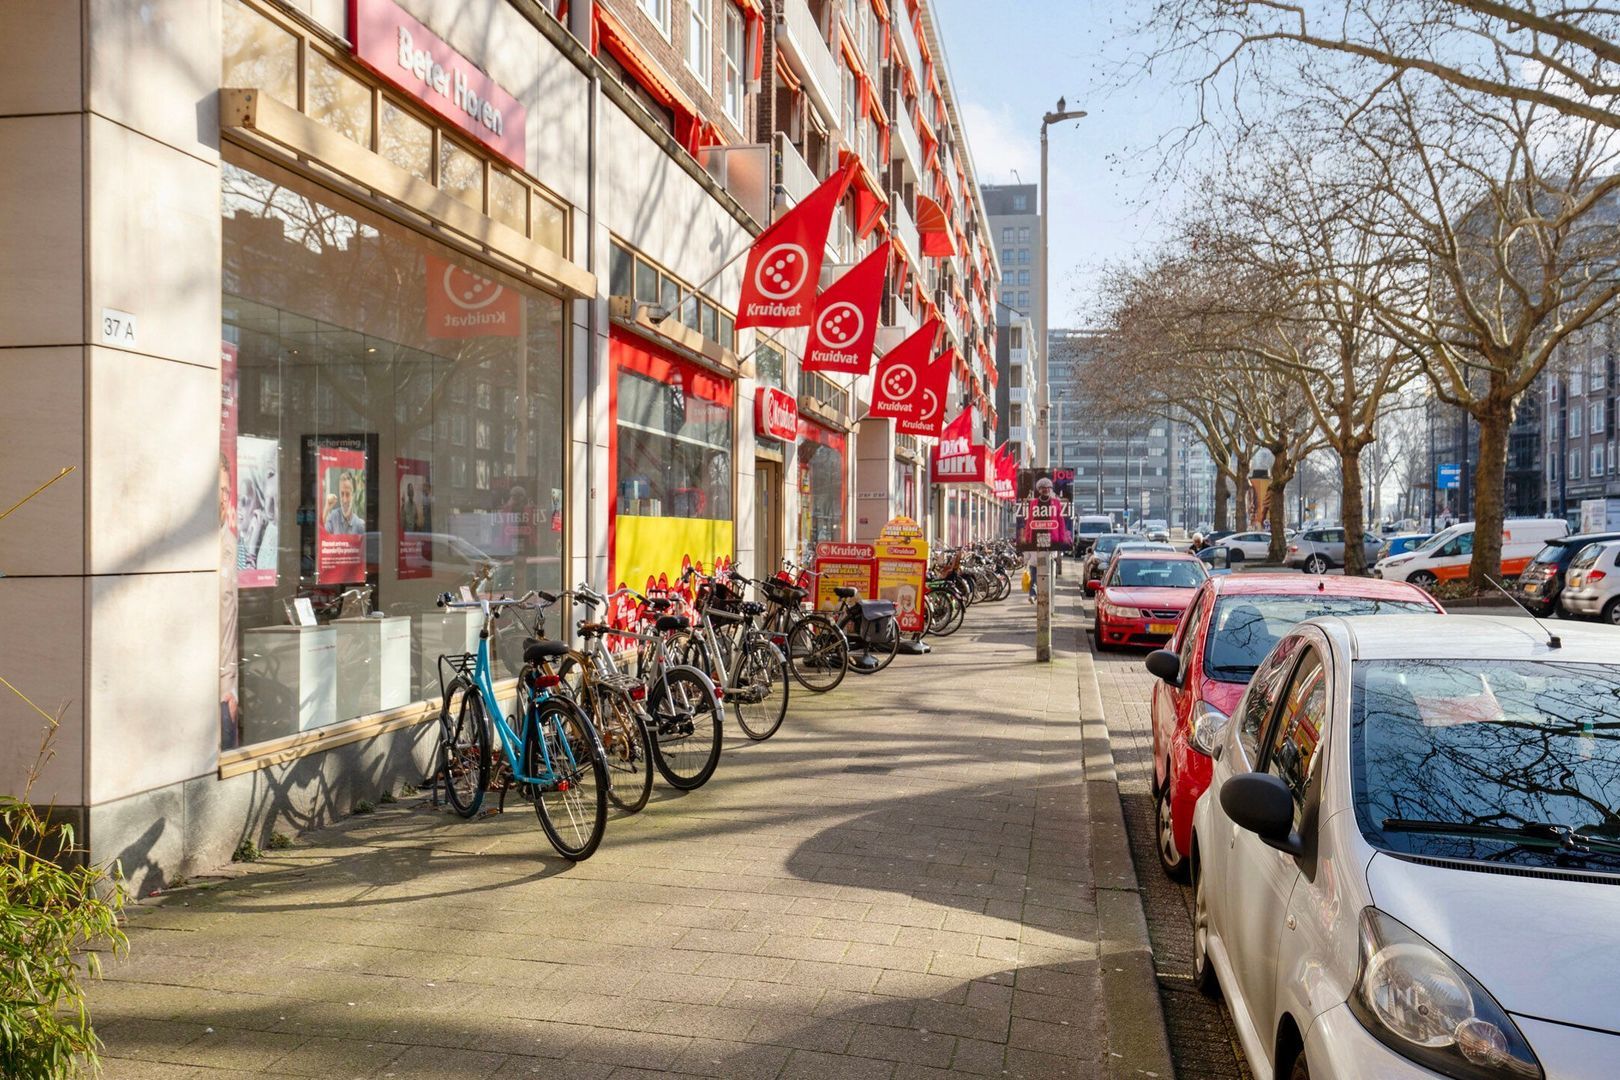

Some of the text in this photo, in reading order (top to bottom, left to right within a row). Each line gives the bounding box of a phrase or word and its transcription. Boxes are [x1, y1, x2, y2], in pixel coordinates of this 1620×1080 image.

[398, 26, 503, 136] Beter Horen
[746, 302, 801, 317] Kruidvat
[104, 317, 134, 341] 37 A
[811, 350, 858, 365] Kruidvat
[877, 400, 913, 412] Kruidvat
[902, 419, 934, 431] Kruidvat
[940, 436, 970, 458] Dirk
[1053, 468, 1073, 483] jou
[1015, 502, 1075, 520] Zij aan Zij
[831, 545, 872, 556] Kruidvat
